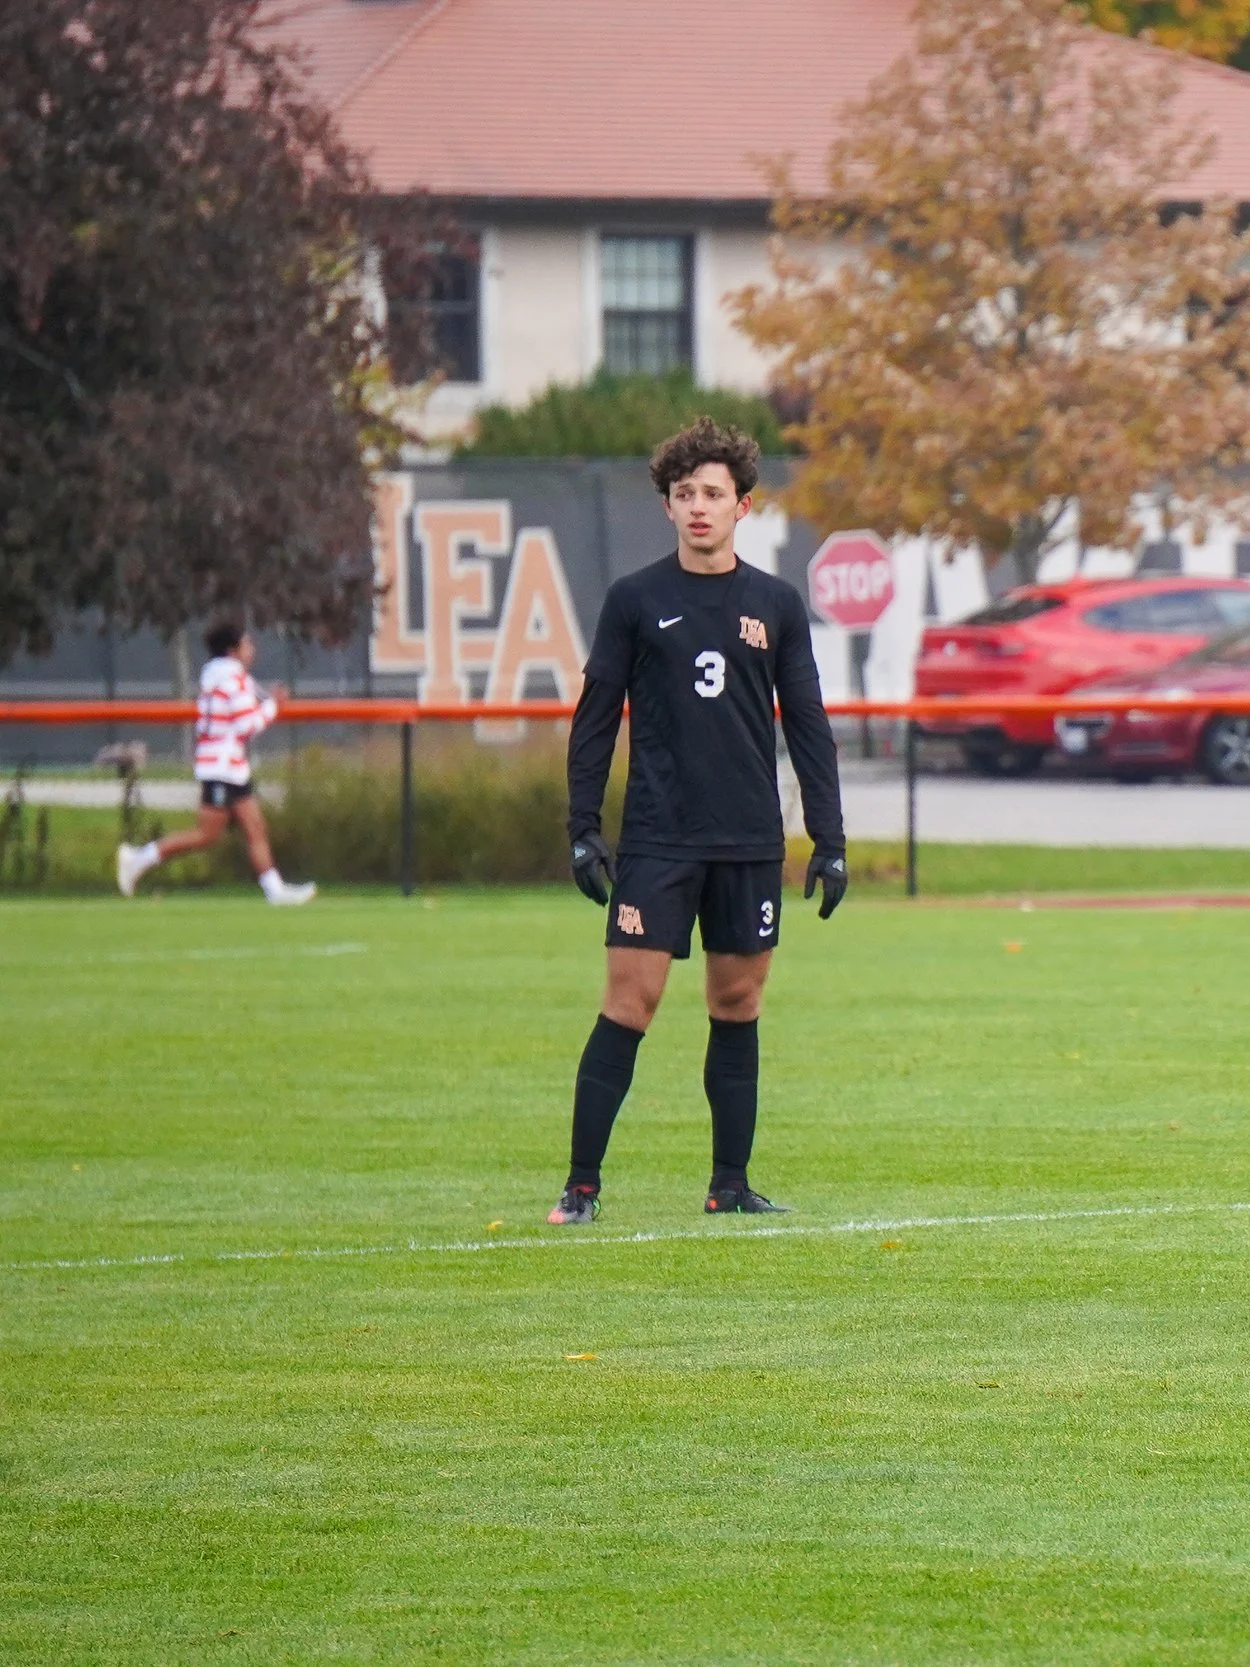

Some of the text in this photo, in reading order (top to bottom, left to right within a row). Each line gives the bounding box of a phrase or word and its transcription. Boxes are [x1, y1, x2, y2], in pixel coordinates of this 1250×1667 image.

[816, 560, 891, 604] STOP
[369, 472, 590, 742] LFA
[739, 615, 769, 650] LFA
[694, 650, 726, 698] 3
[760, 900, 774, 925] 3
